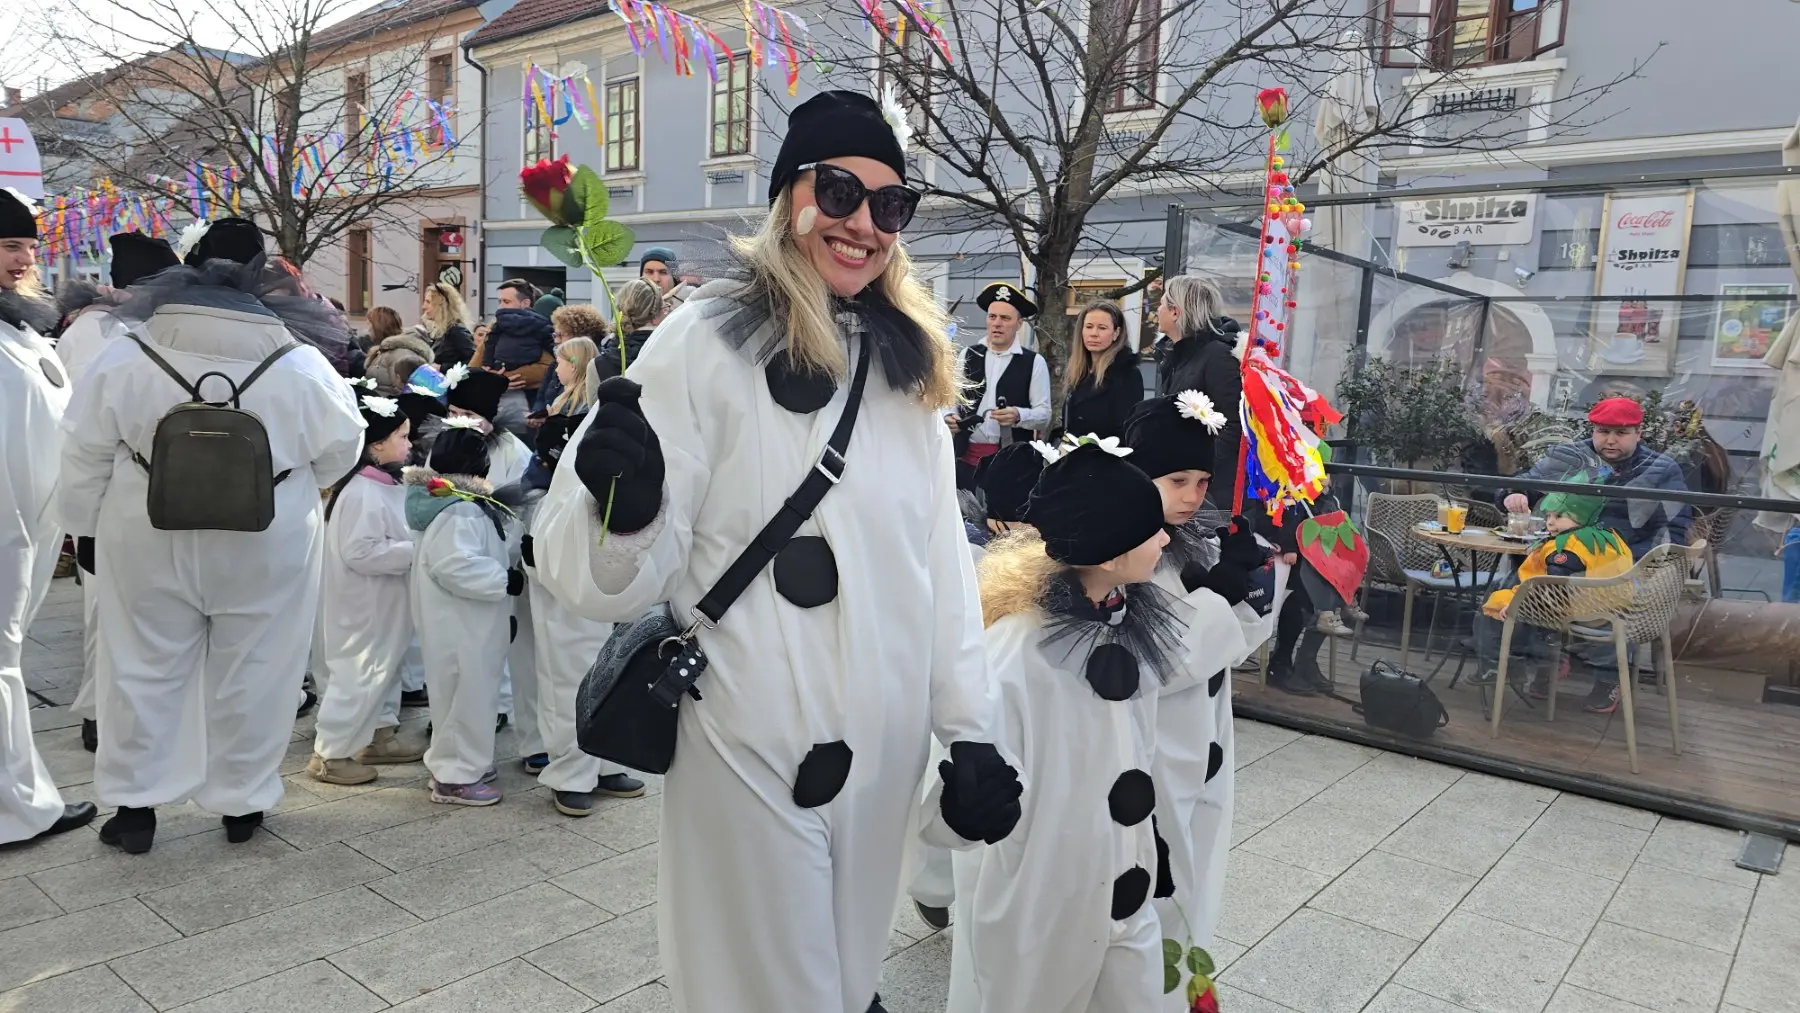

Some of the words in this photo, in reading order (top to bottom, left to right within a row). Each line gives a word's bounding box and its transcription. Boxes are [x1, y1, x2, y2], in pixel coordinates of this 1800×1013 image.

[1425, 197, 1528, 221] Shpitza
[1453, 224, 1483, 235] BAR
[1618, 248, 1680, 261] Shpitza
